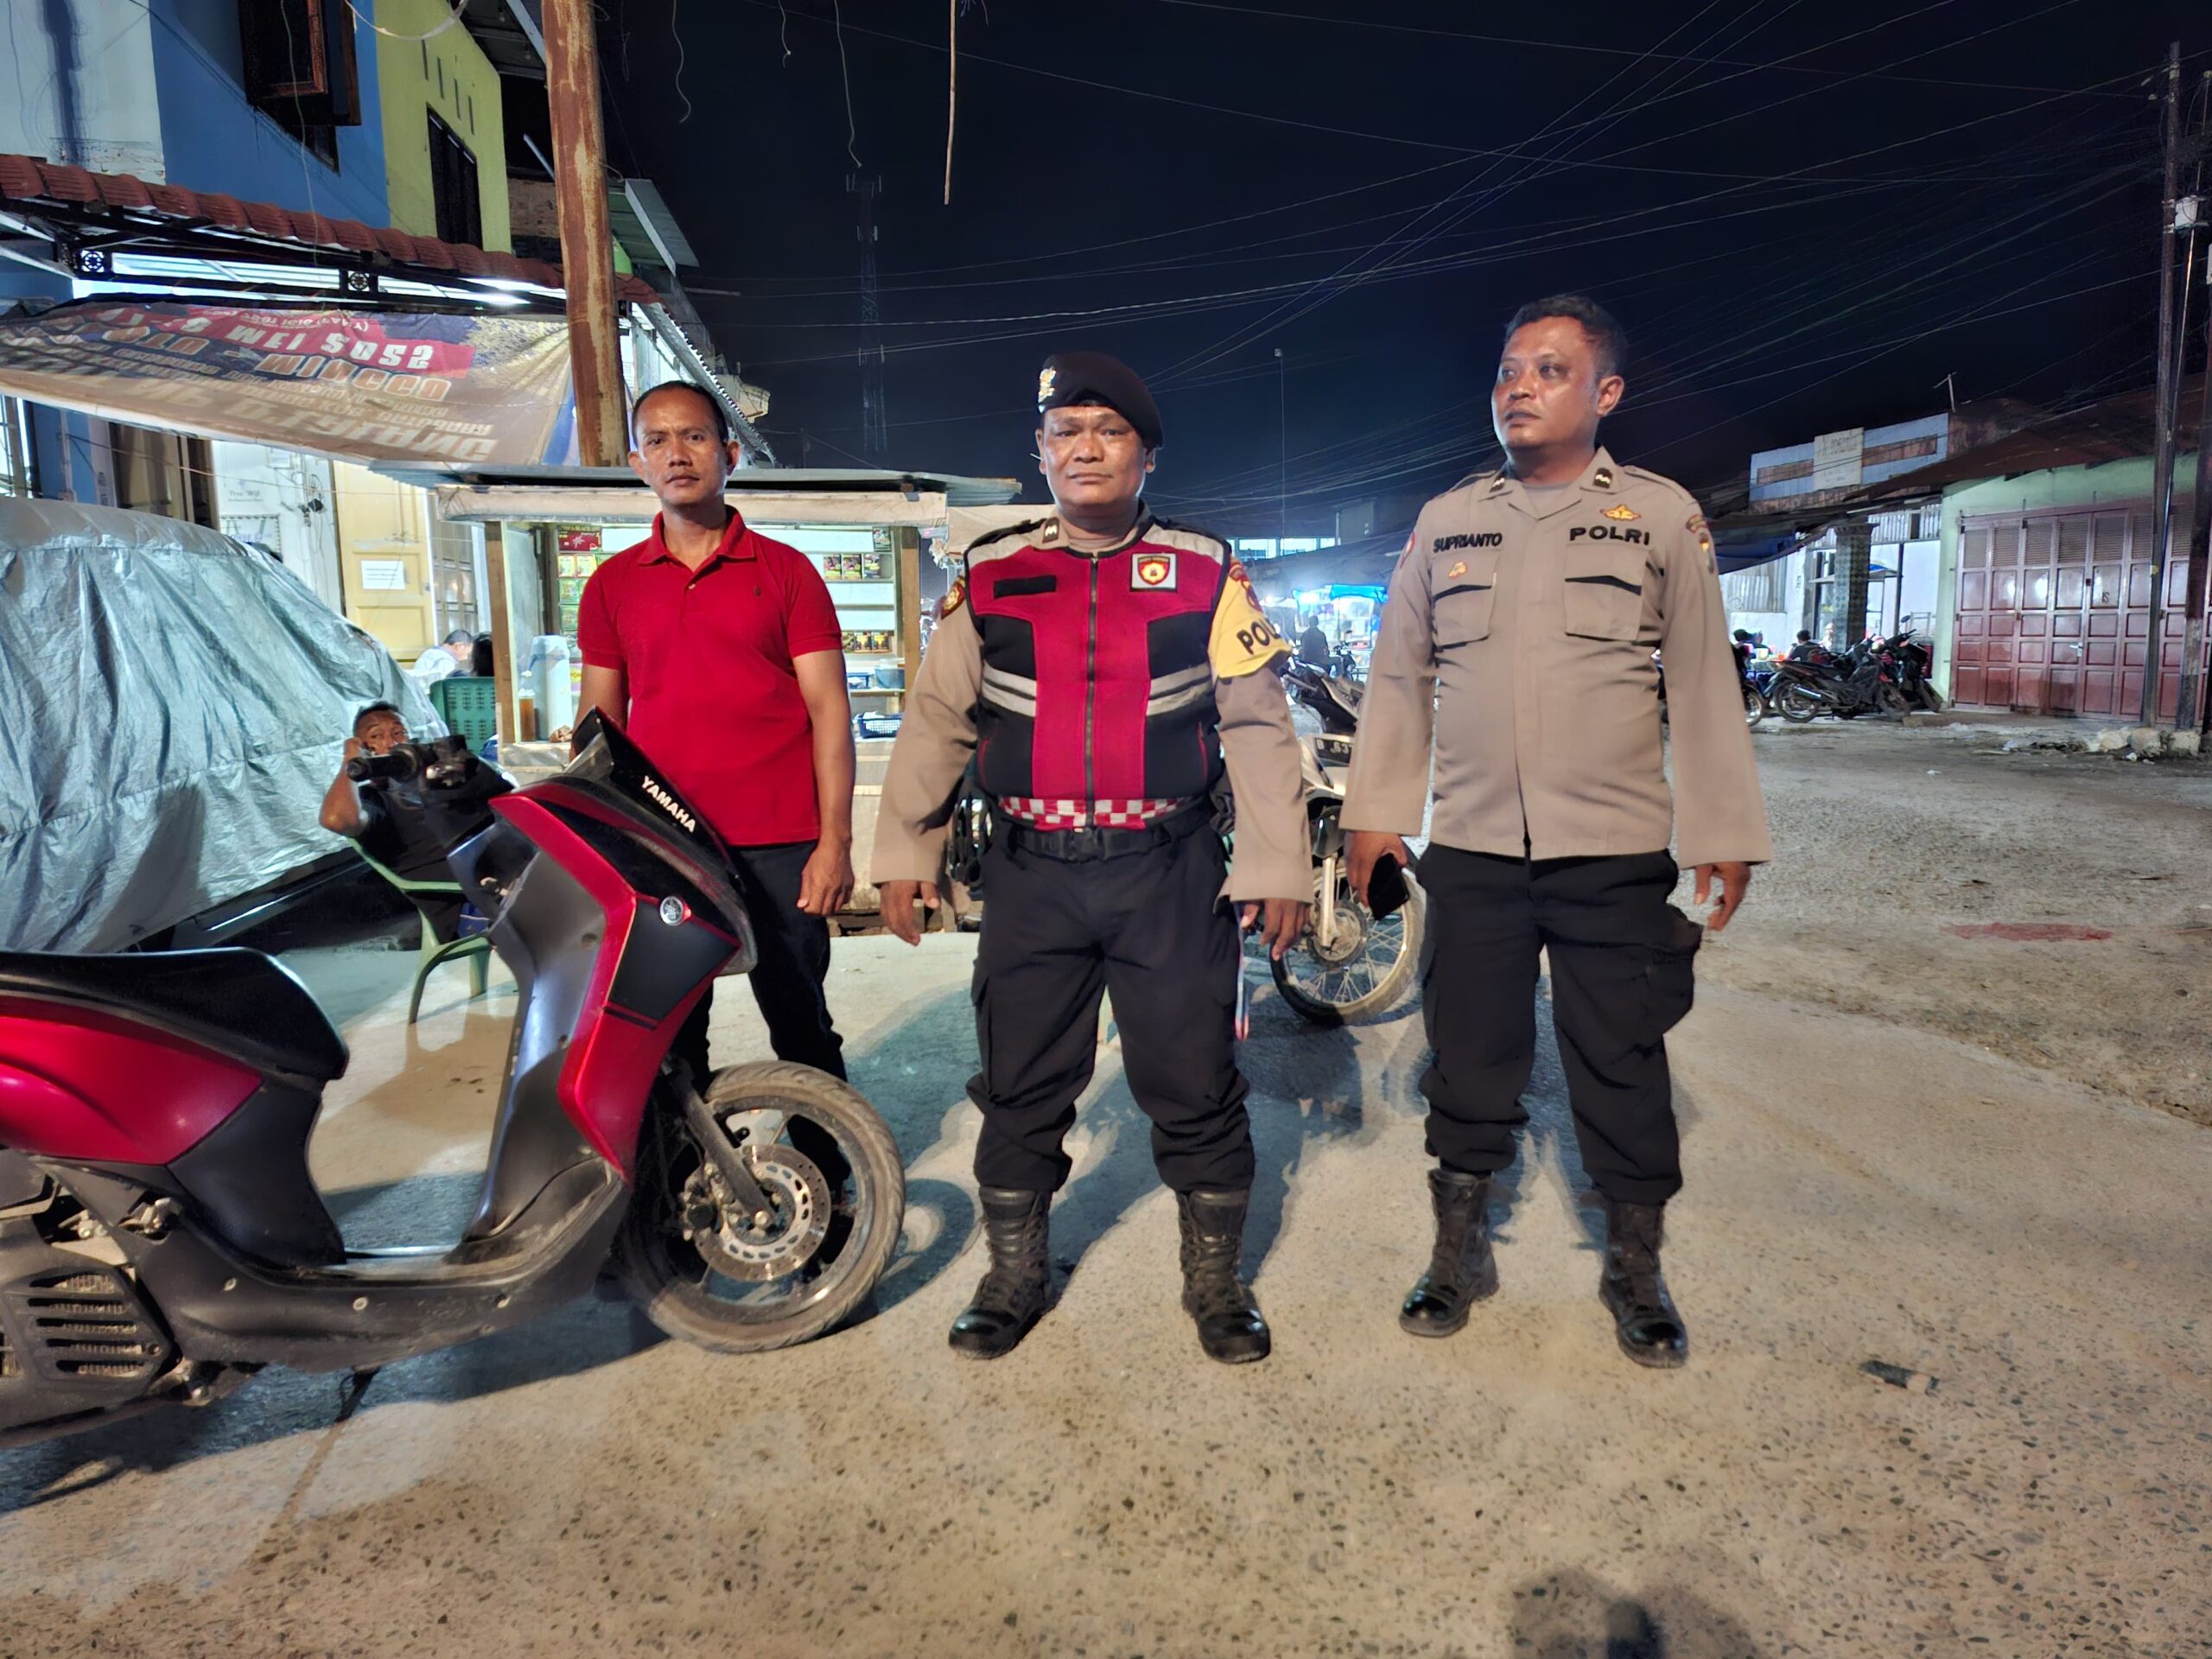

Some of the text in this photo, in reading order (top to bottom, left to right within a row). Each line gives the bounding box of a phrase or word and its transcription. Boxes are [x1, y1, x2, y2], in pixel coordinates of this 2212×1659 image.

[1433, 532, 1503, 554] SUPRIANTO
[1569, 525, 1650, 546] POLRI
[642, 775, 696, 833] YAMAHA
